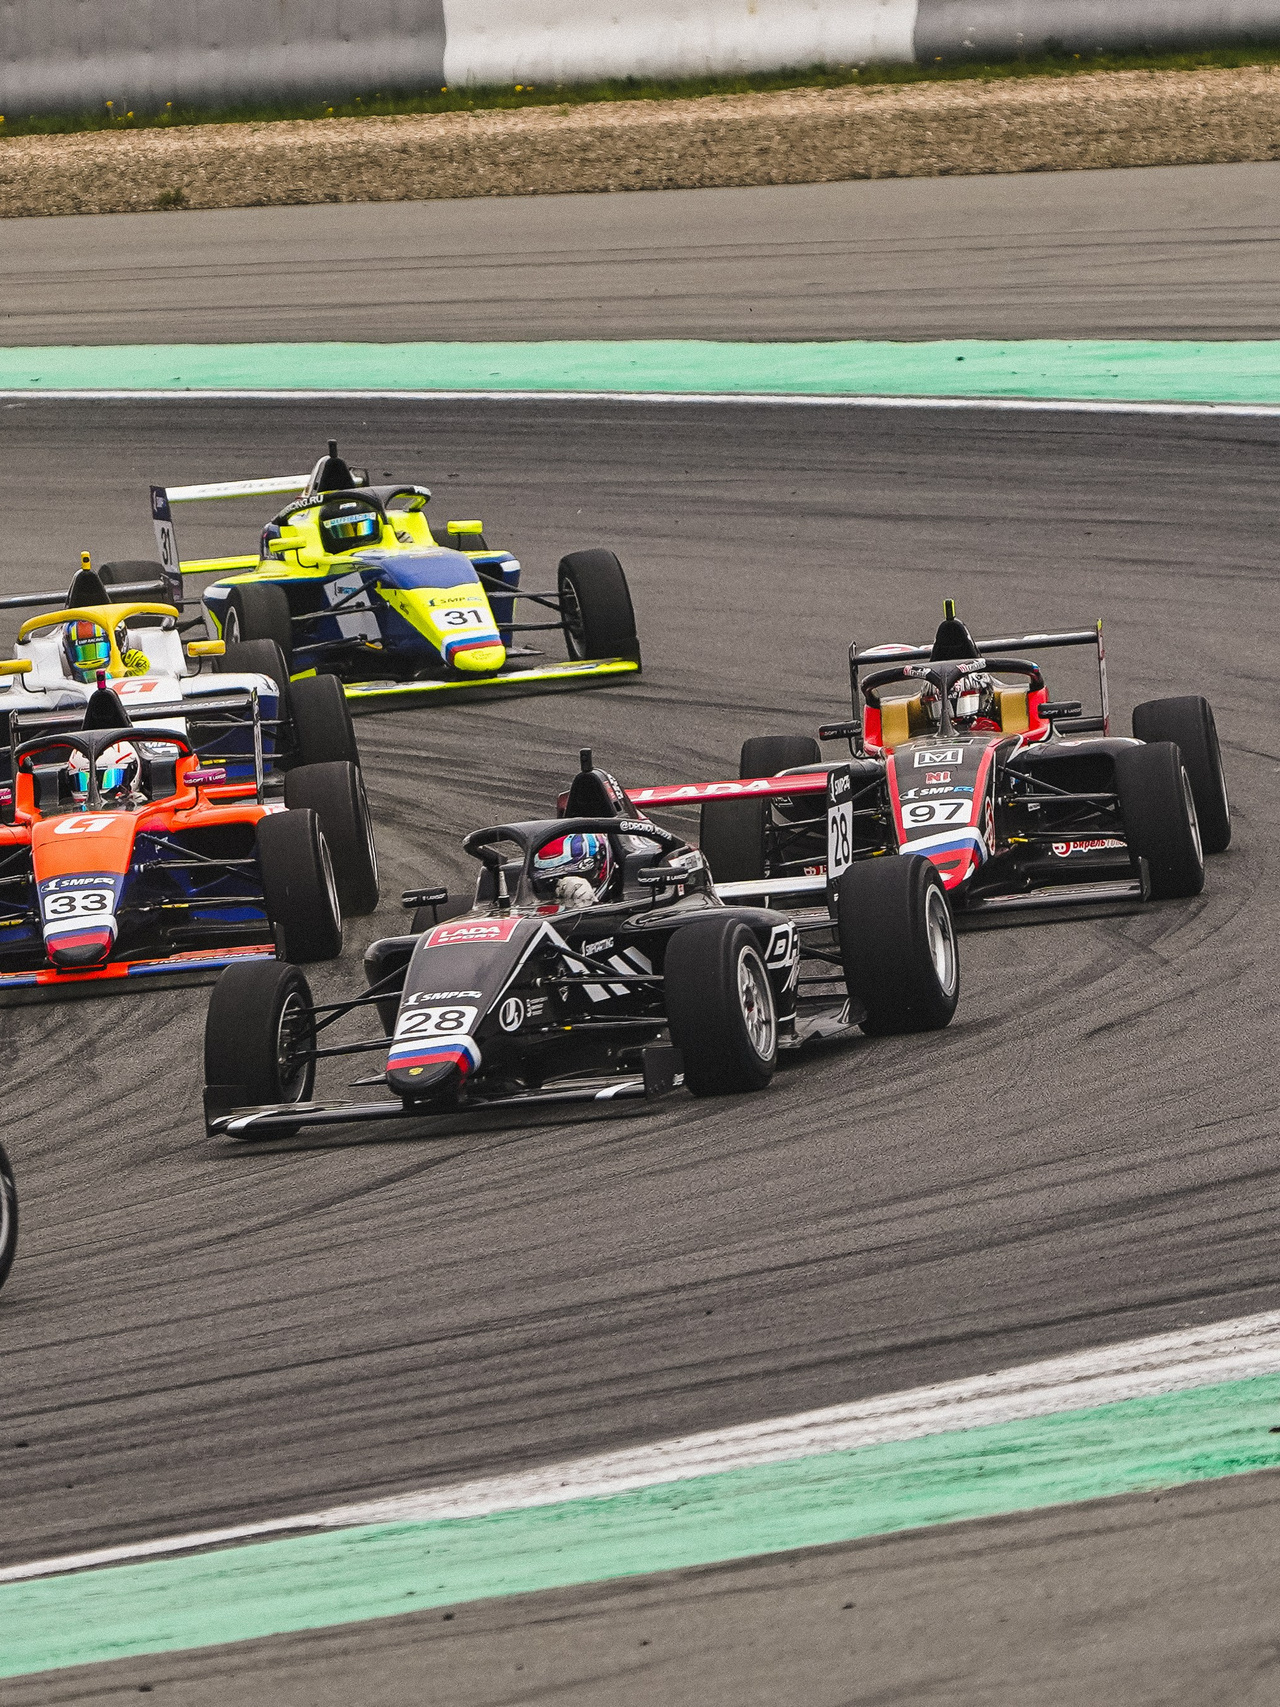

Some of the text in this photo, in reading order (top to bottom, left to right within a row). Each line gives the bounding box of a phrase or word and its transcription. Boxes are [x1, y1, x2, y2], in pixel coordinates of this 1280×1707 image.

[161, 526, 173, 567] 31
[444, 609, 483, 626] 31
[631, 778, 771, 802] LADA
[909, 802, 964, 823] 97
[831, 812, 850, 867] 28
[50, 893, 107, 915] 33
[437, 933, 500, 943] SPORT
[439, 926, 501, 938] LADA
[400, 1009, 466, 1035] 28
